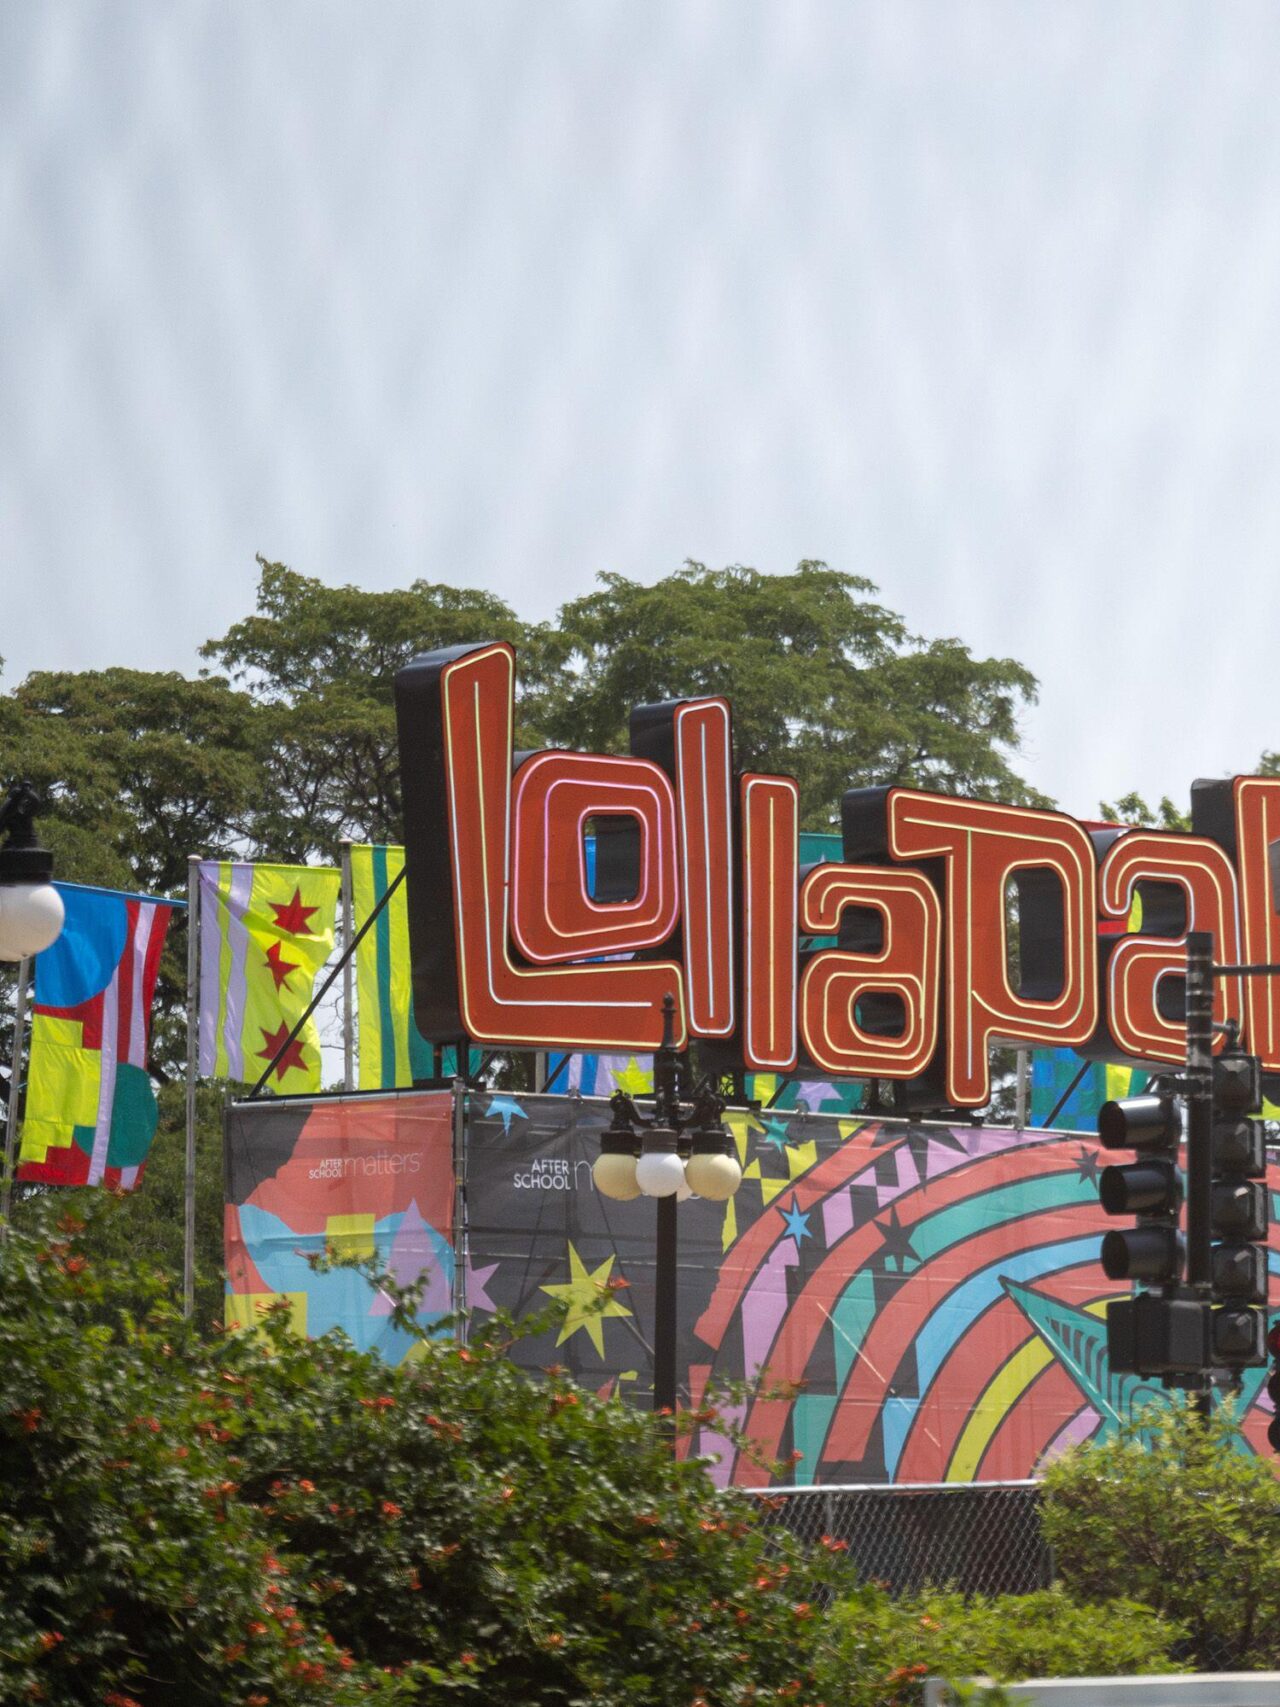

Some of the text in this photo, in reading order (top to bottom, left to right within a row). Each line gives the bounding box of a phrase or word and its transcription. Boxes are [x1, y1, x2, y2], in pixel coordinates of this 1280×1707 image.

[320, 1158, 342, 1169] AFTER
[343, 1149, 421, 1177] matters
[531, 1159, 570, 1175] AFTER
[308, 1168, 342, 1179] SCHOOL
[513, 1173, 571, 1190] SCHOOL
